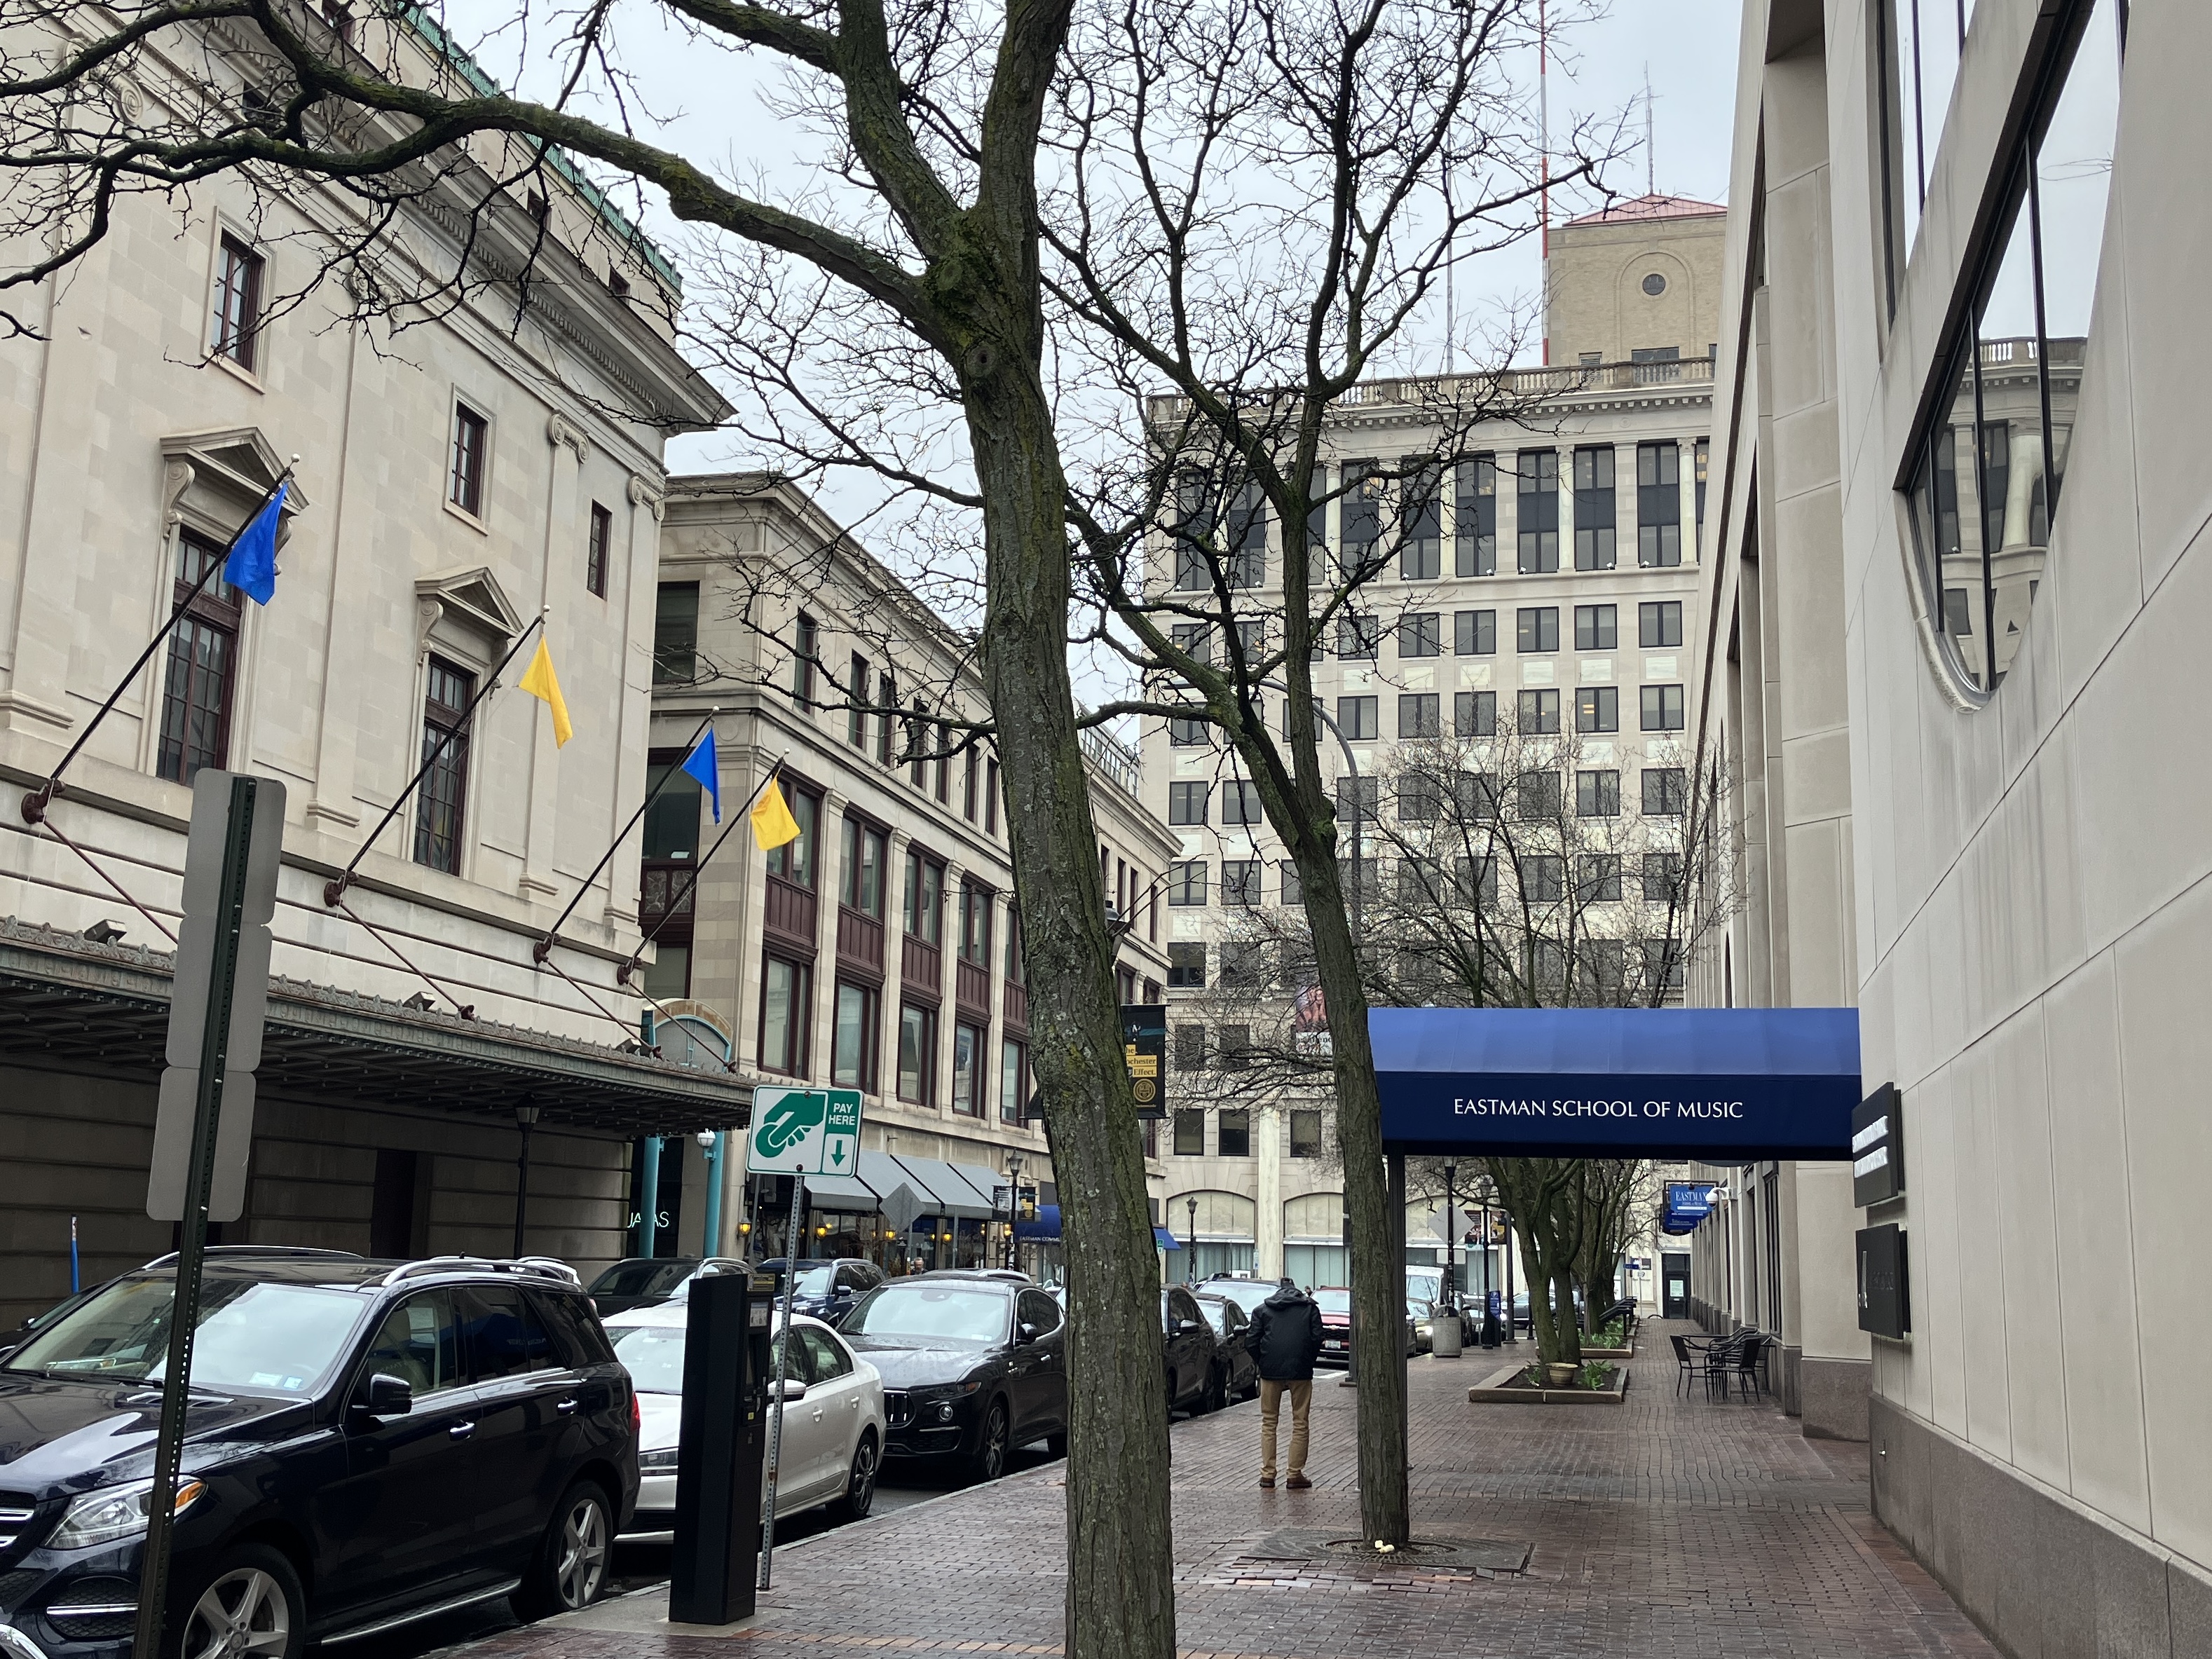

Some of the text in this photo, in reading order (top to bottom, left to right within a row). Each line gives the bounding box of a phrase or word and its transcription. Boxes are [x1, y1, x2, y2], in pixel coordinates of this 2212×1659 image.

[833, 1102, 853, 1114] PAY
[1454, 1098, 1743, 1118] EASTMAN SCHOOL OF MUSIC
[828, 1114, 856, 1126] HERE
[627, 1211, 669, 1228] JAAS
